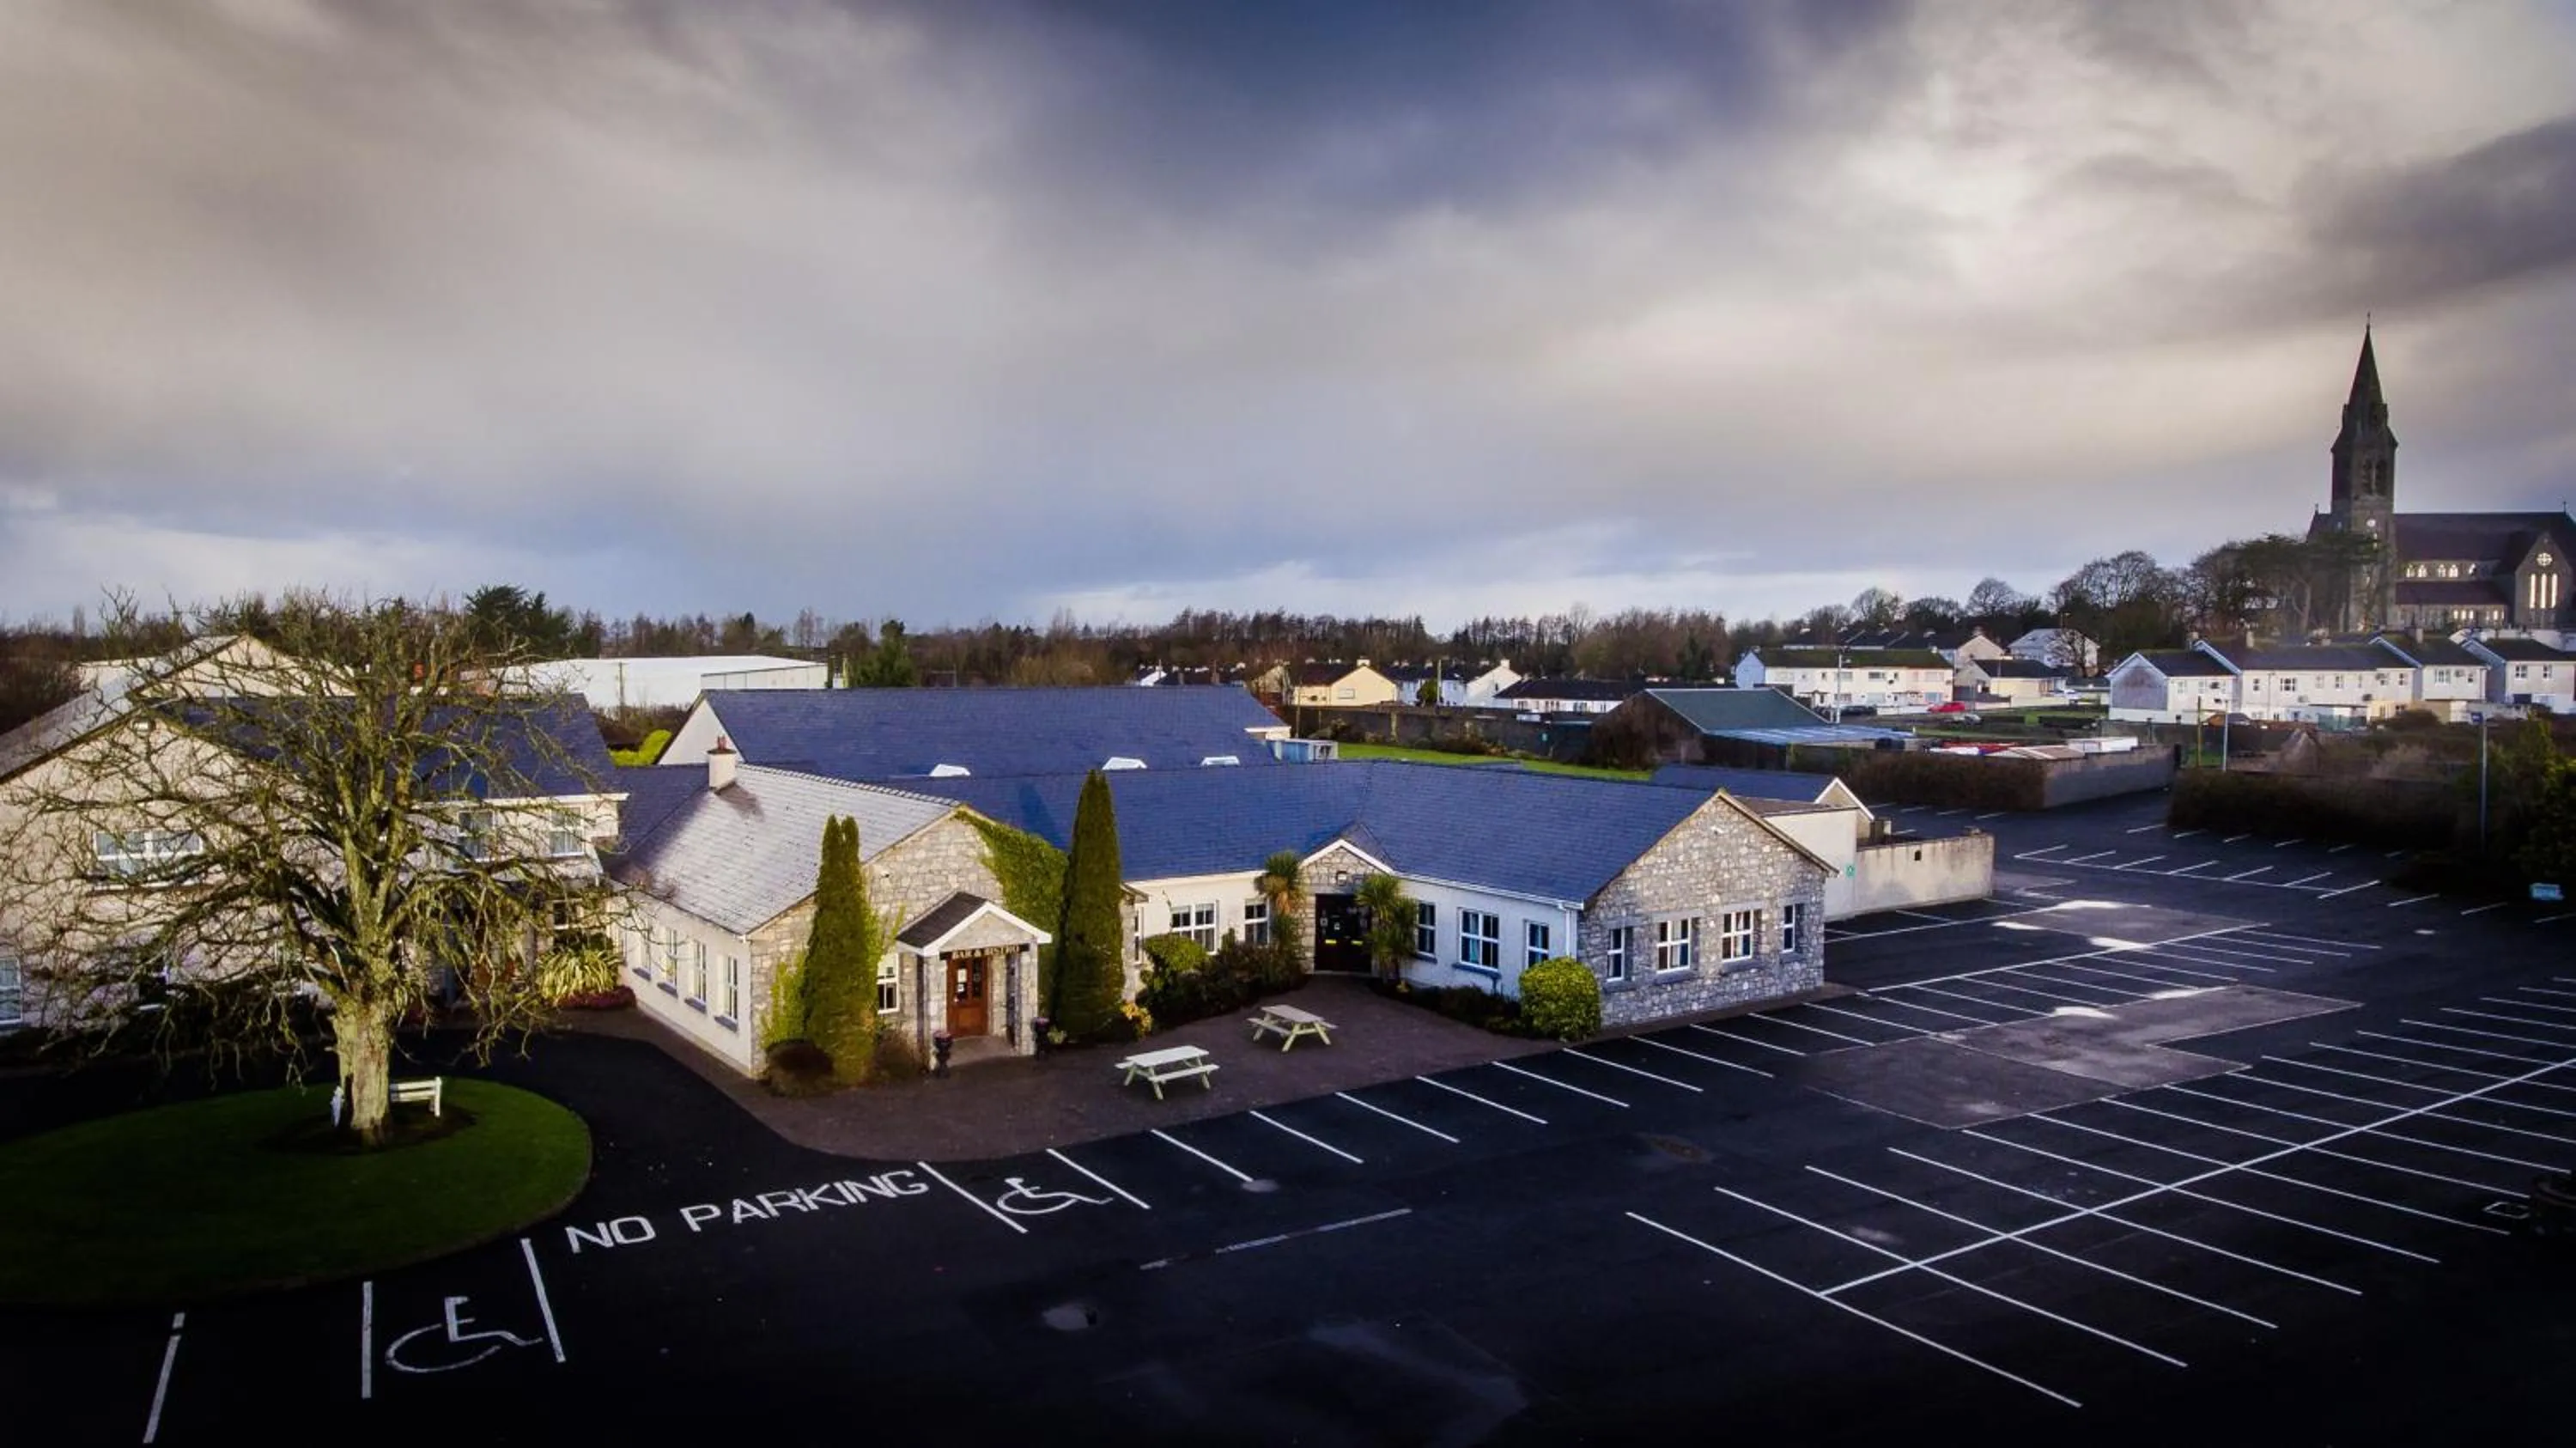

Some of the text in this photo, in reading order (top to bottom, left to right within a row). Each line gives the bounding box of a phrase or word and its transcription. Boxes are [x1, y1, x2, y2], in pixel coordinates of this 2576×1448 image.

[952, 945, 1020, 959] BAR & BISTRO
[565, 1170, 929, 1252] NO PARKING
